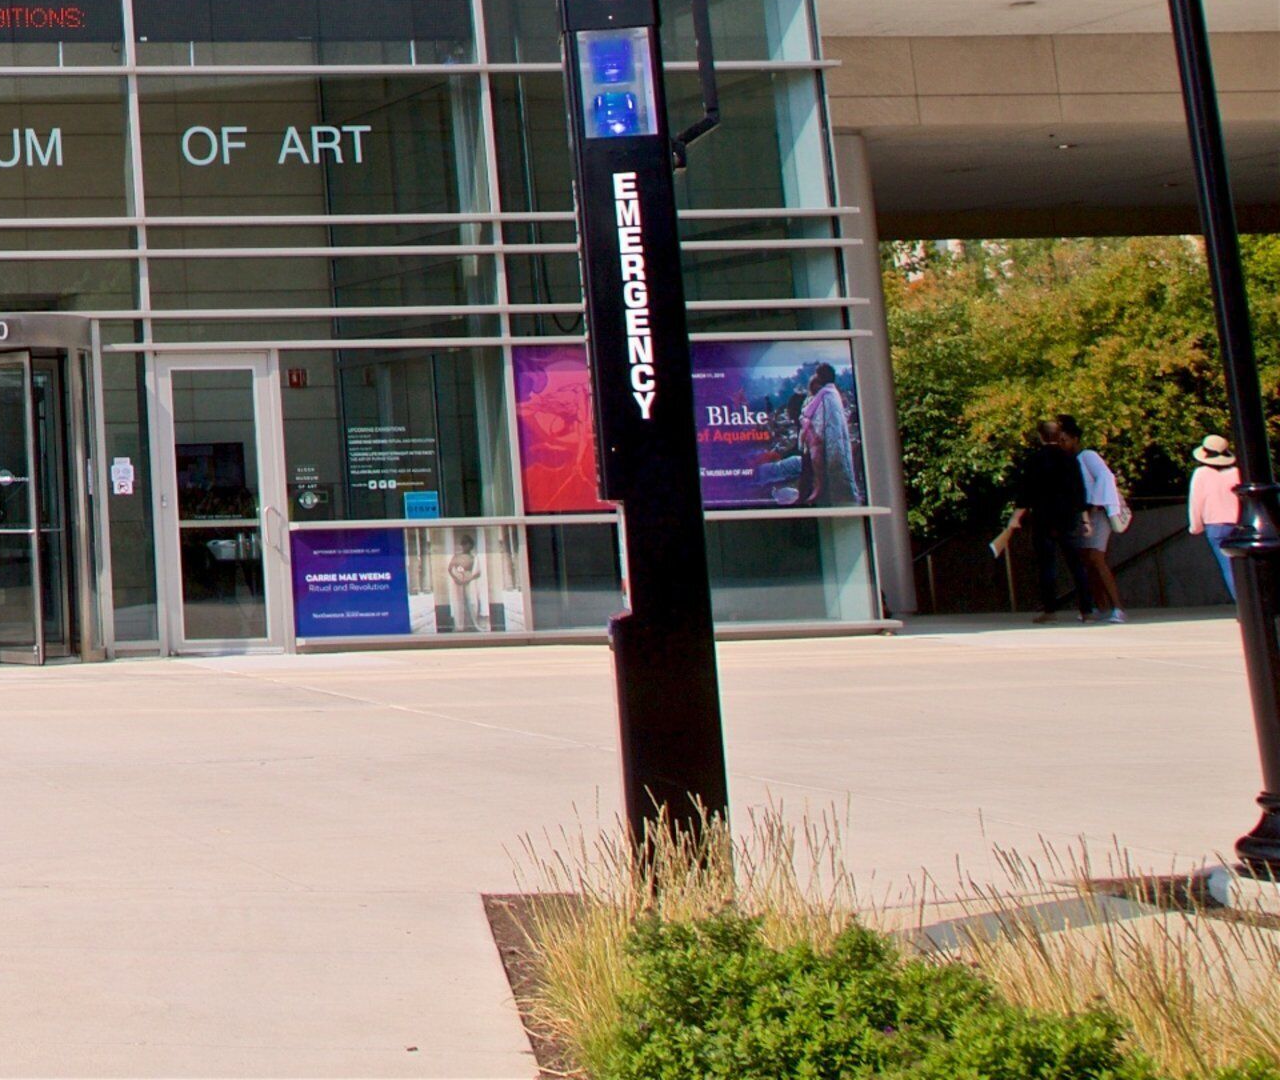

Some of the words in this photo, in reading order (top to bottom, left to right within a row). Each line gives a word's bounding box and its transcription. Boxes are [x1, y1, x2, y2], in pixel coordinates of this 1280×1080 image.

[182, 126, 247, 166] OF
[278, 125, 372, 164] ART
[613, 171, 656, 420] EMERGENCY
[706, 406, 769, 426] Blake
[713, 429, 770, 445] Aquarius
[305, 573, 337, 582] CARRIE
[338, 573, 358, 581] MAE
[359, 572, 391, 581] WEEMS
[309, 584, 331, 592] Ritual
[333, 583, 348, 591] and
[349, 582, 389, 591] Revolution
